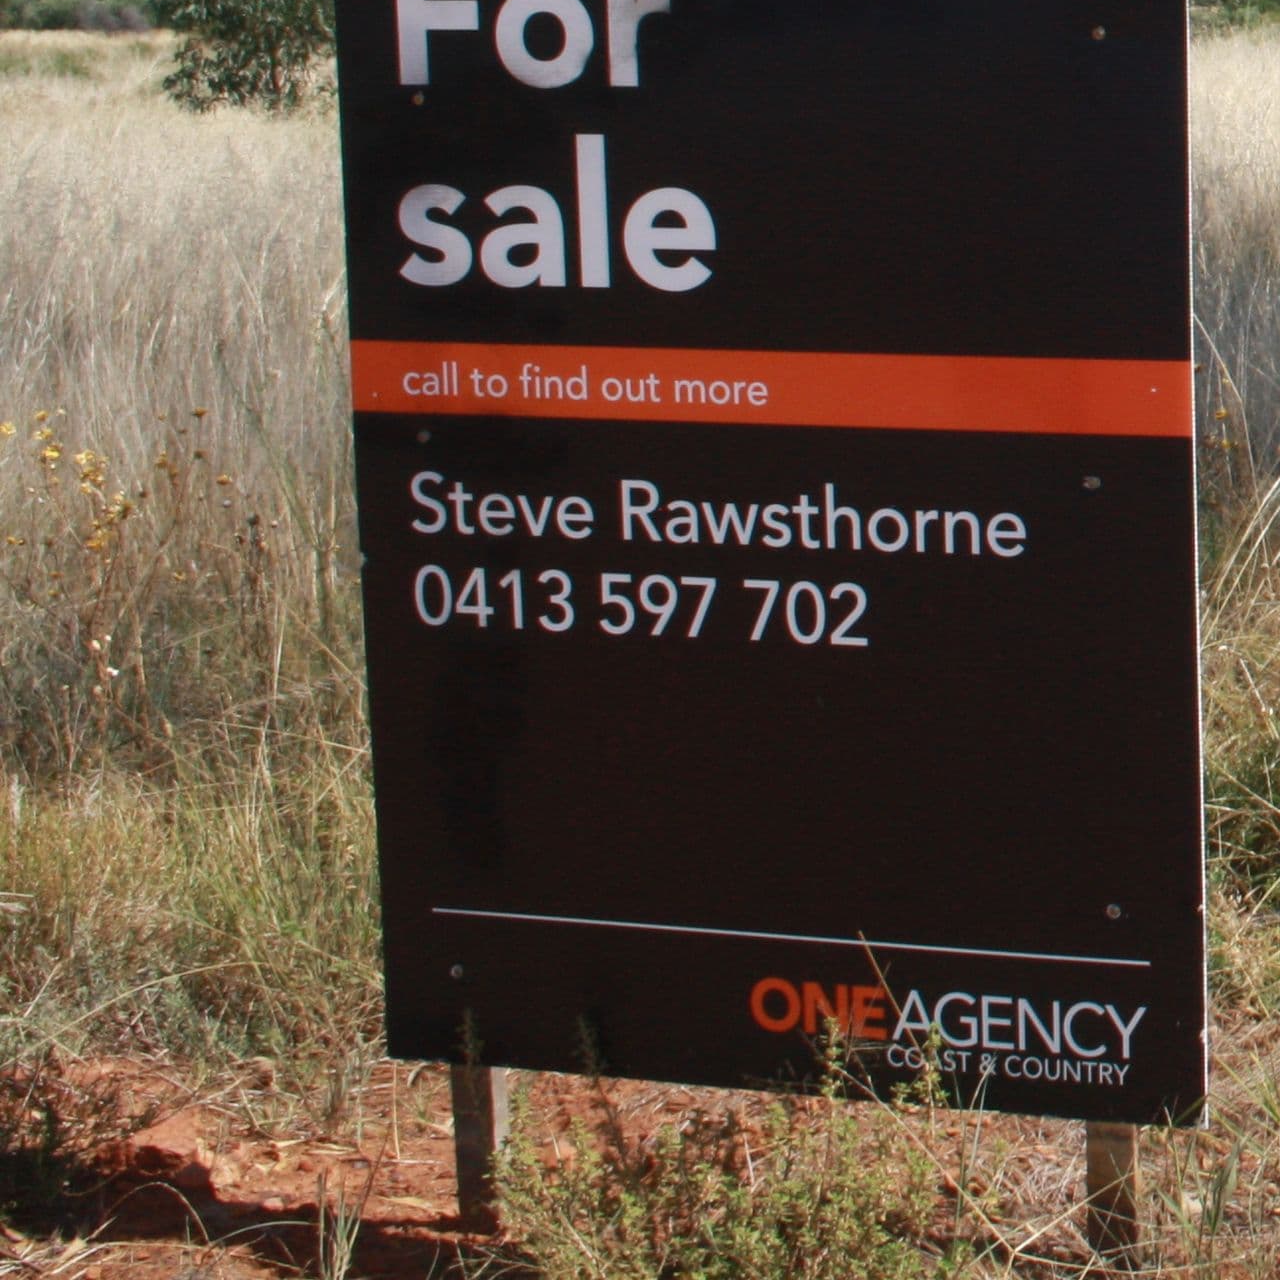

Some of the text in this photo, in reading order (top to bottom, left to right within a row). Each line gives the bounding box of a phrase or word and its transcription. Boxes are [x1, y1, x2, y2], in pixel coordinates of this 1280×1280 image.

[399, 133, 717, 292] sale
[402, 361, 769, 406] call to find out more
[410, 471, 1027, 557] Steve Rawsthorne
[413, 564, 869, 646] 0413 597 702
[751, 978, 1146, 1059] ONE AGENCY
[1004, 1055, 1130, 1086] COUNTRY
